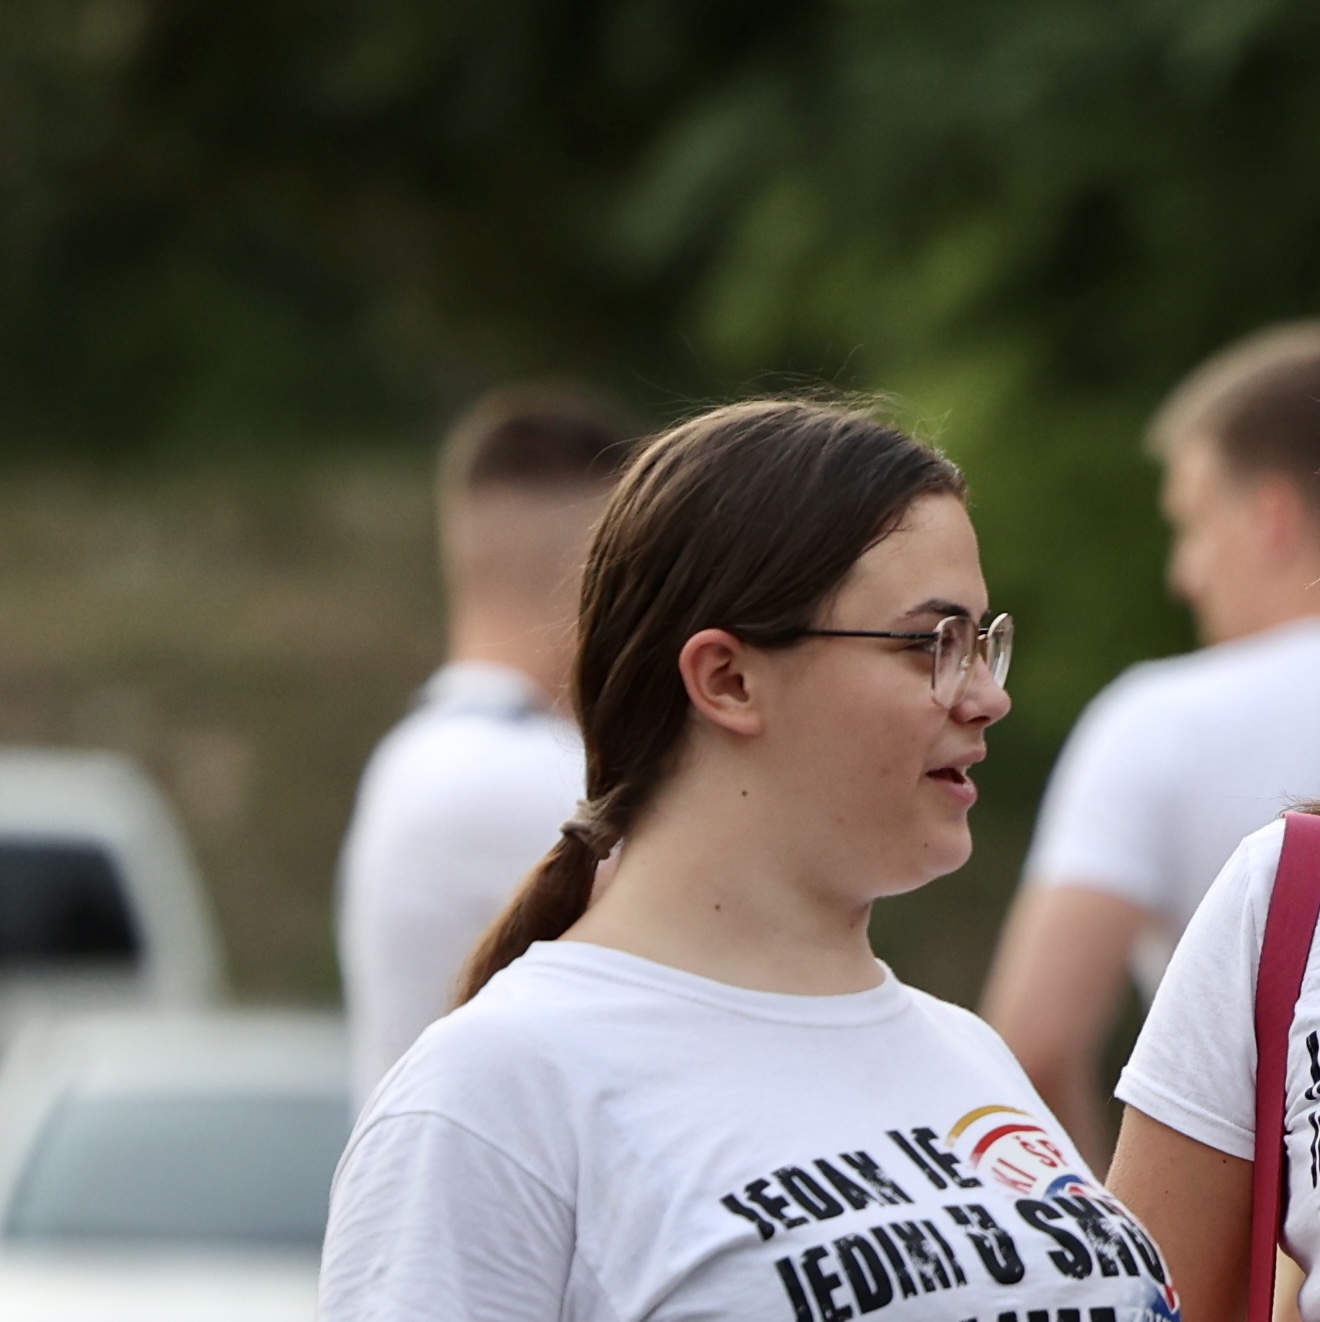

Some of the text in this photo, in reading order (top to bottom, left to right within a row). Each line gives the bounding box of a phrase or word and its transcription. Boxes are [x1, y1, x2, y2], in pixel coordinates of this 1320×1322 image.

[720, 1127, 982, 1241] JEDAN JE
[946, 1204, 1025, 1284] U
[1015, 1195, 1166, 1285] SNU
